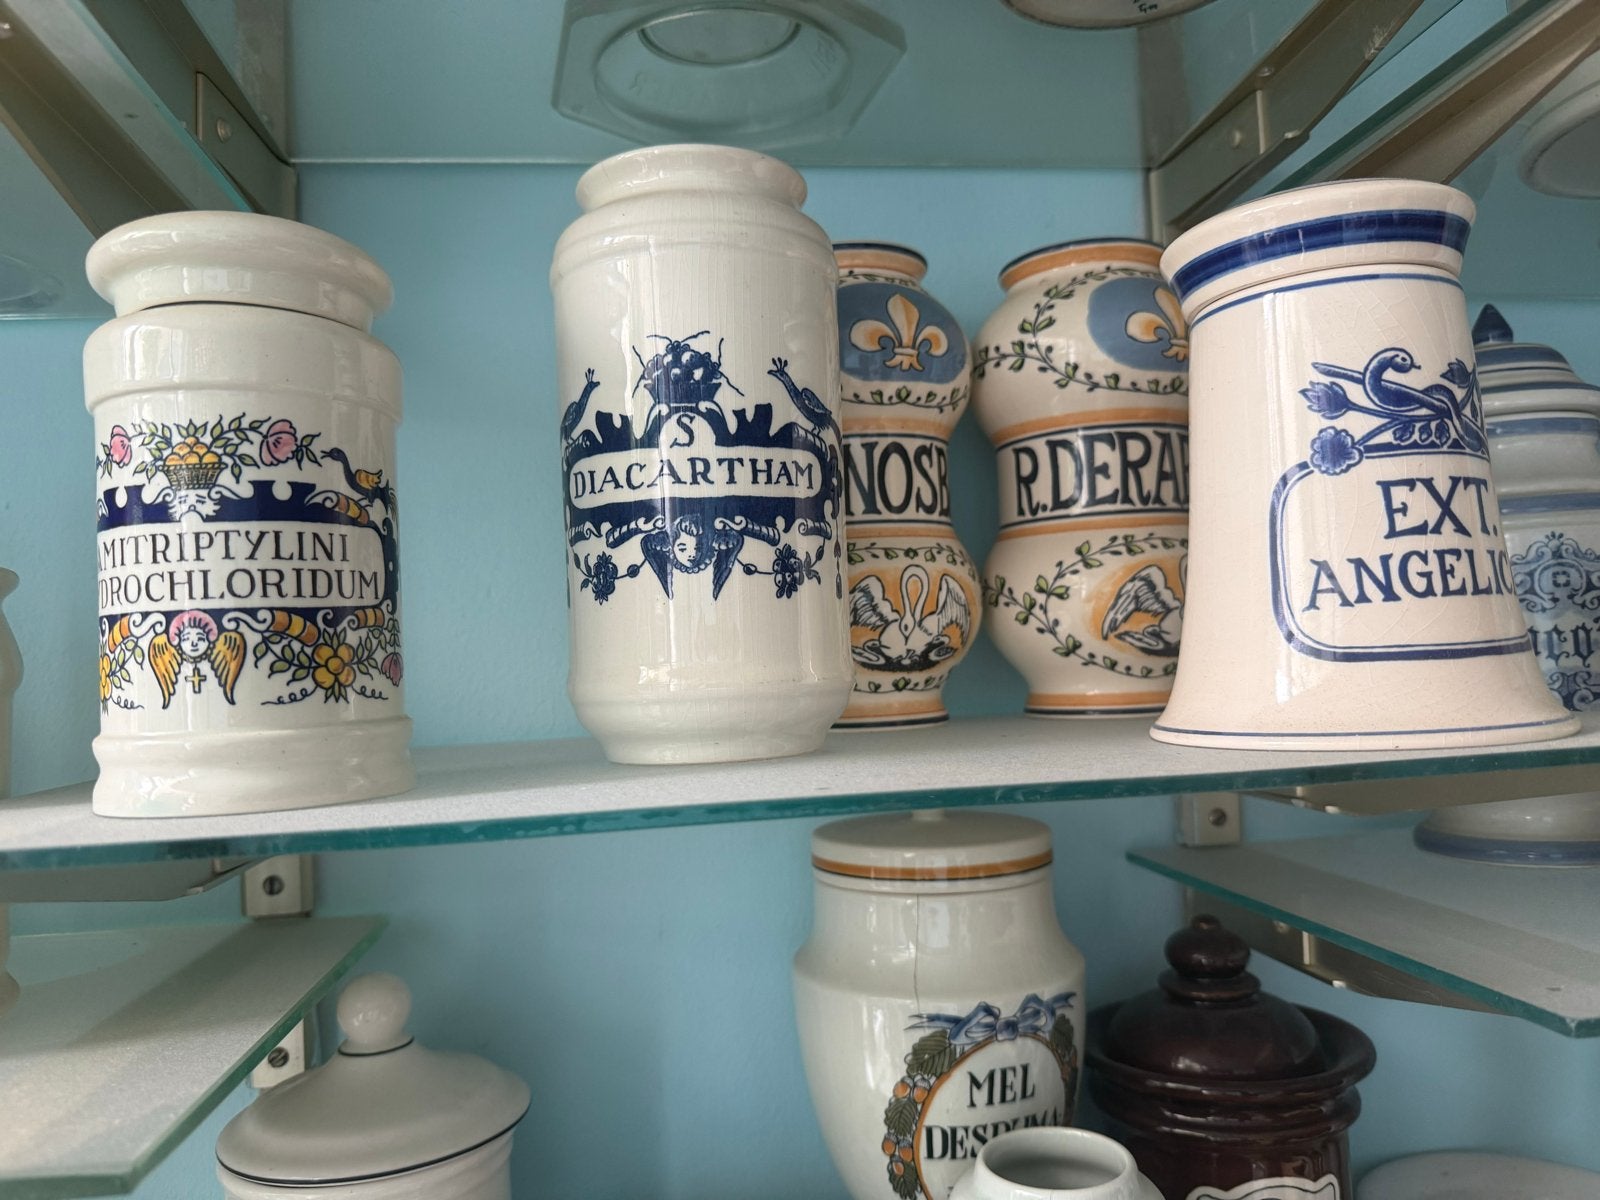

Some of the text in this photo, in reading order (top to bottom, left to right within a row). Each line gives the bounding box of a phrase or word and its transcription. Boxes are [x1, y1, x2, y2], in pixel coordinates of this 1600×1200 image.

[670, 412, 695, 448] S
[573, 457, 814, 499] DIACARTHAM
[1376, 475, 1498, 539] EXT.
[98, 530, 351, 572] MITRIPTYLINI
[967, 1063, 1036, 1108] MEL
